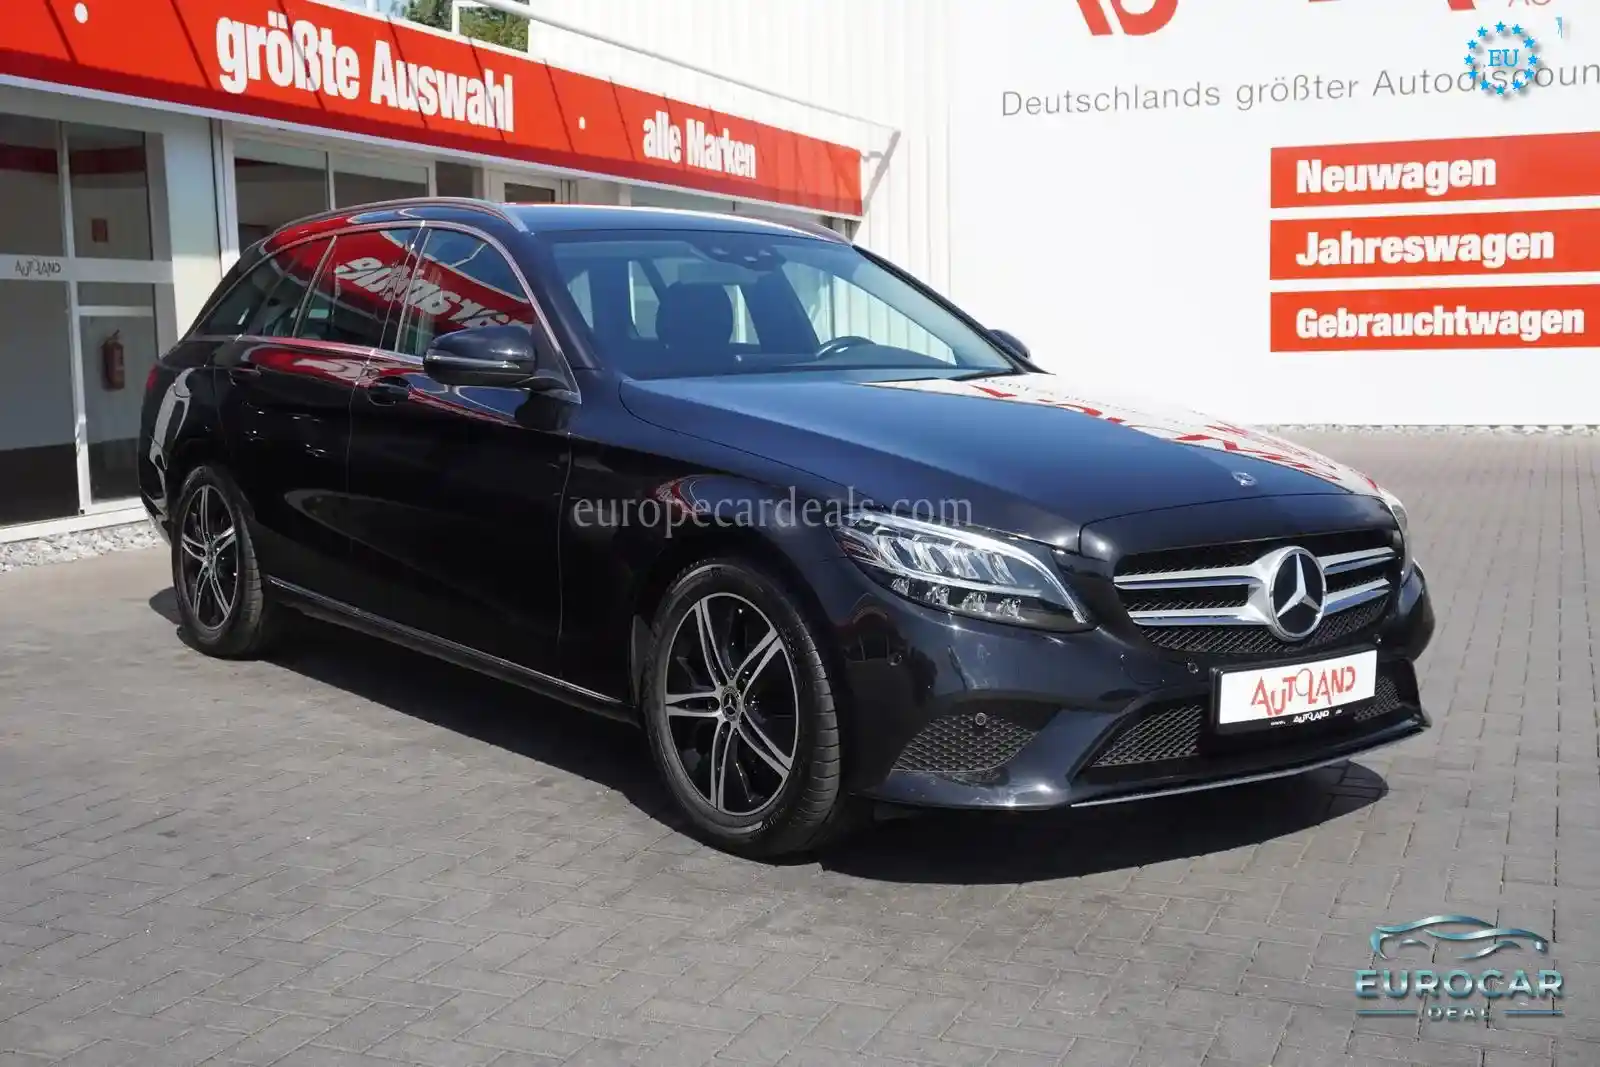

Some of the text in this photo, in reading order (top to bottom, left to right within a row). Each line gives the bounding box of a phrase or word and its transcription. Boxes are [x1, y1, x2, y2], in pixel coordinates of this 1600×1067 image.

[216, 11, 514, 133] größte Auswahl
[1002, 81, 1220, 117] Deutschlands
[1236, 74, 1358, 111] größter
[643, 110, 756, 179] alle Marken
[1296, 157, 1496, 196] Neuwagen
[1296, 231, 1554, 268] Jahreswagen
[1296, 306, 1585, 341] Gebrauchtwagen
[1251, 667, 1356, 716] AUTOLAND
